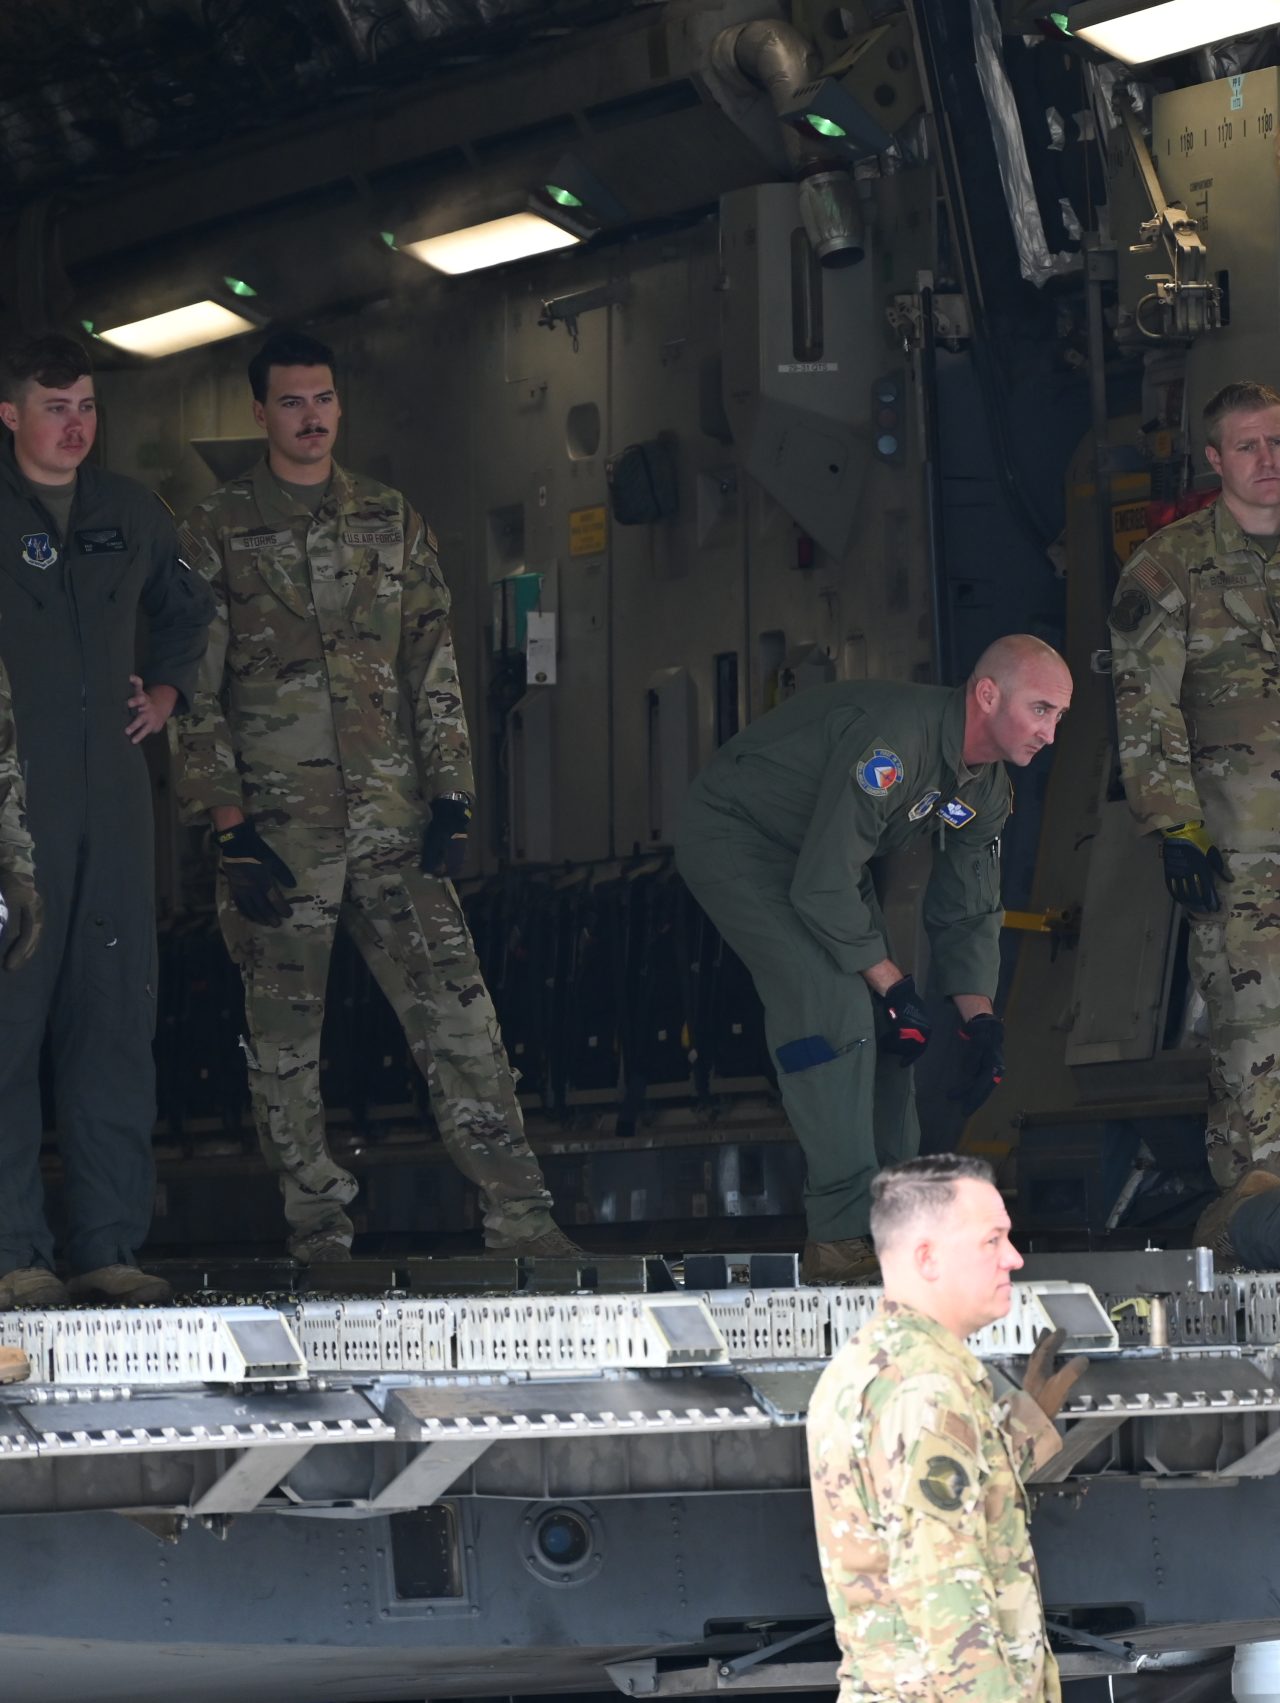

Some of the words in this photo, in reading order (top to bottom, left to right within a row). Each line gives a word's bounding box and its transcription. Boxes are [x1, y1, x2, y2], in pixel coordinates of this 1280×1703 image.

[1217, 123, 1232, 144] 1170
[1257, 113, 1272, 134] 1180
[1180, 130, 1194, 151] 1160
[243, 535, 277, 548] STORMS
[361, 532, 374, 544] AIR
[375, 531, 401, 544] FORCE
